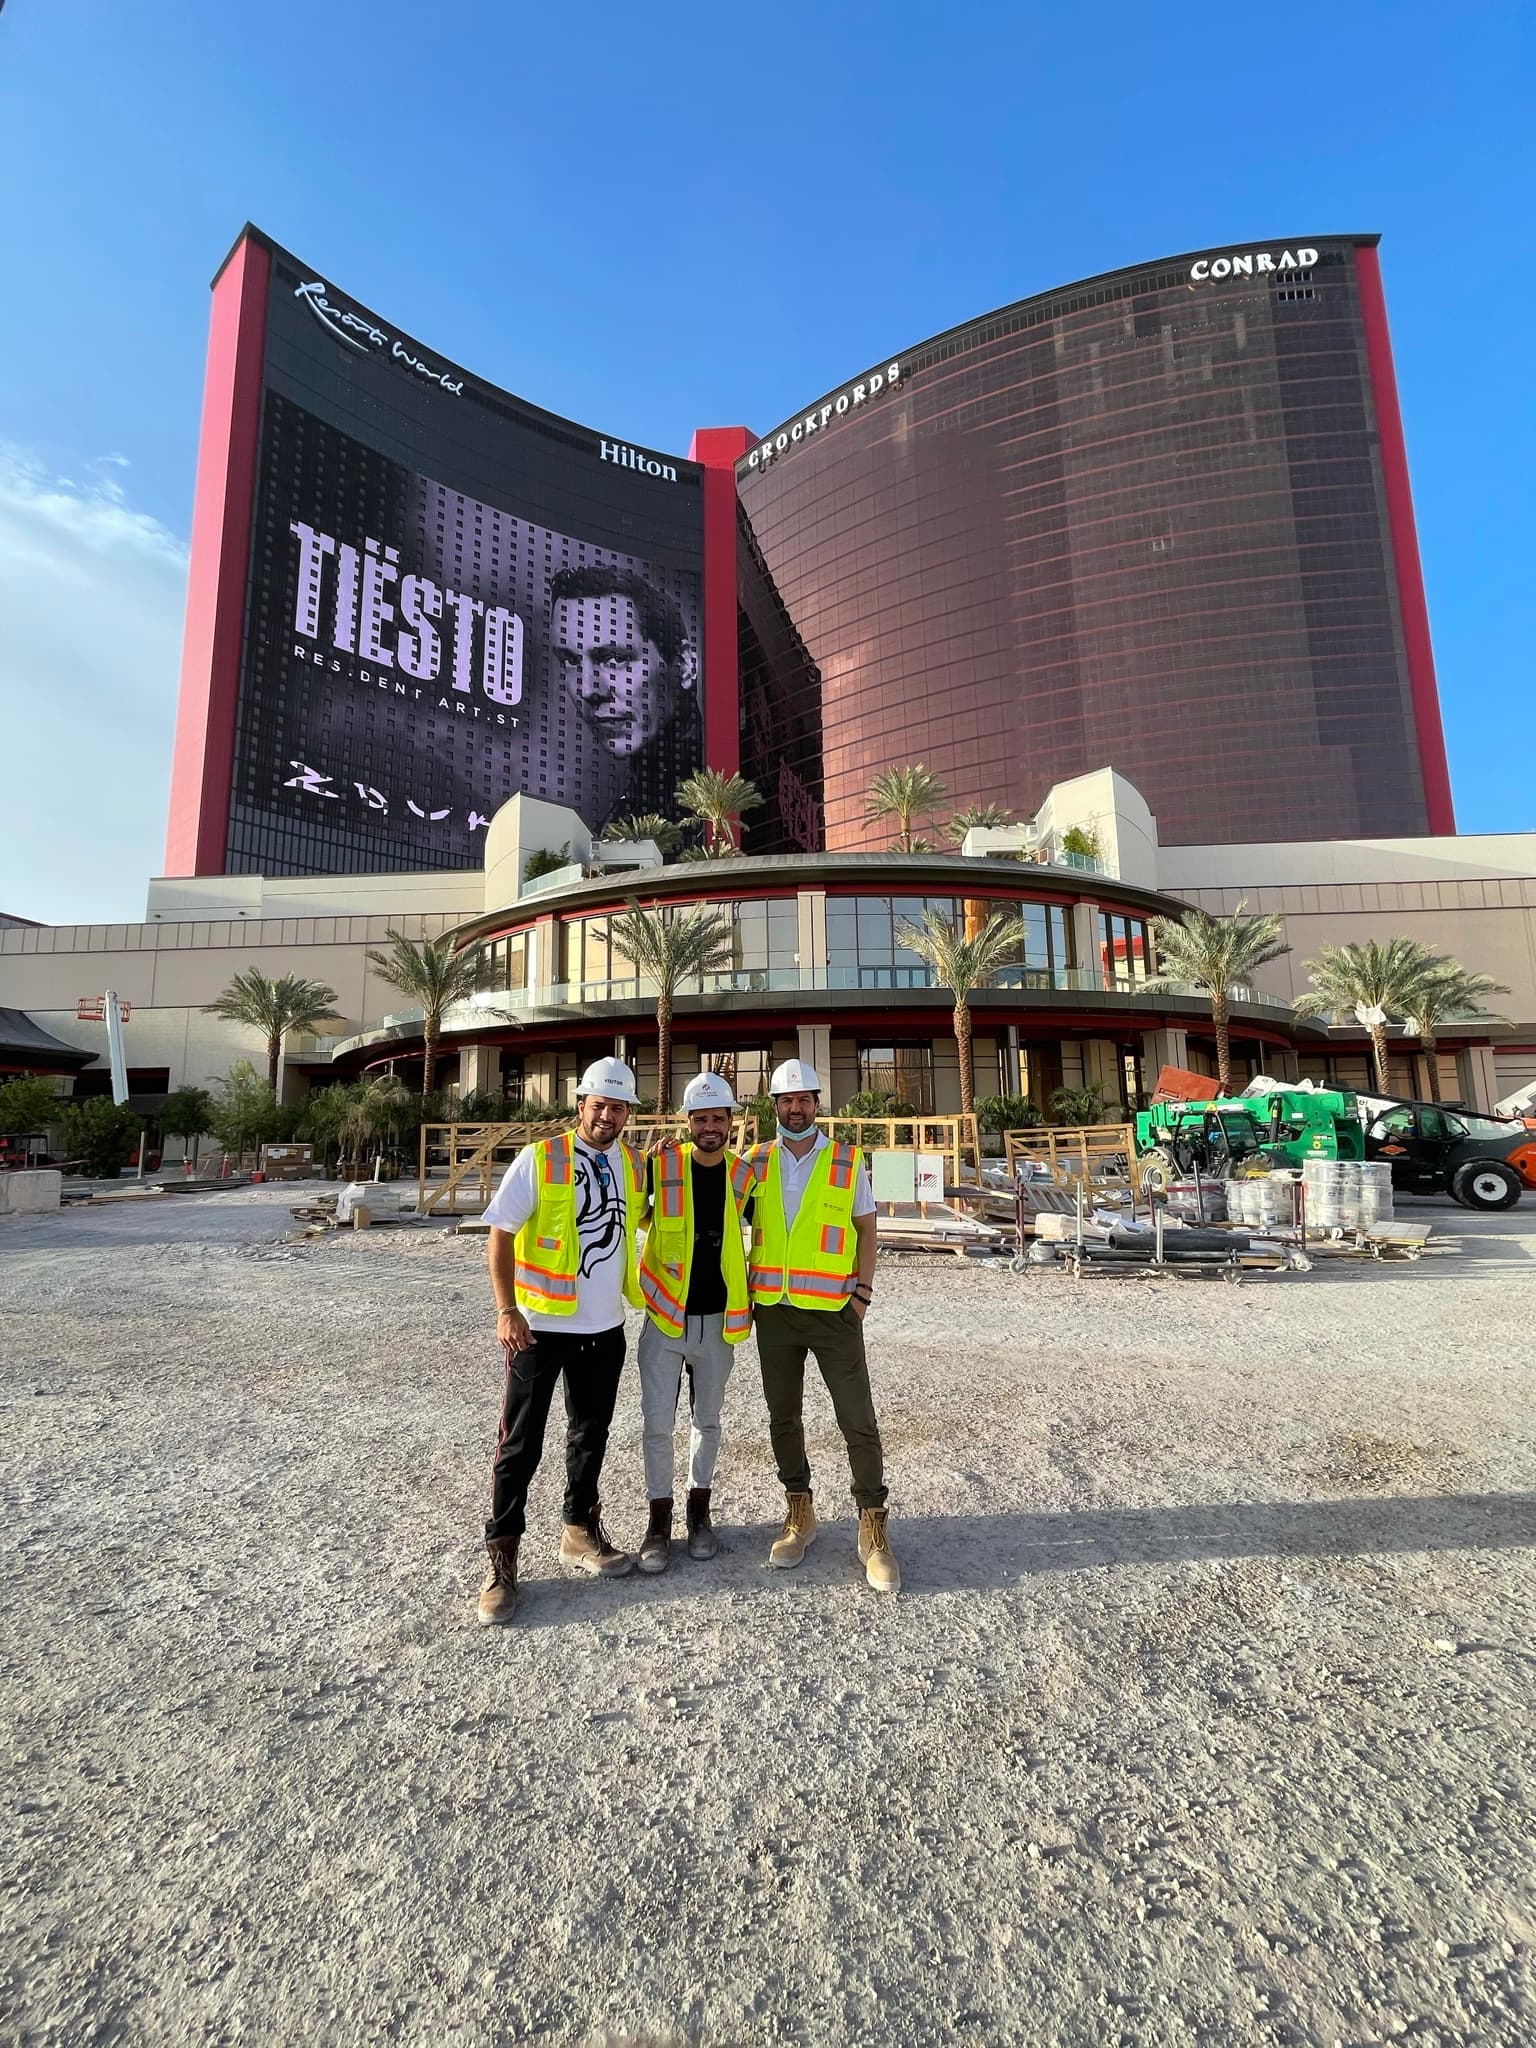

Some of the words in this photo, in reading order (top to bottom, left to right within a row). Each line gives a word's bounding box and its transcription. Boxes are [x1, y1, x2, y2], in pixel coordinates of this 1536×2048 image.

[1190, 248, 1319, 281] CONRAD
[391, 341, 465, 398] World
[748, 362, 900, 467] CROCKFORDS
[599, 440, 679, 483] Hilton
[289, 520, 525, 707] TIËSTO
[293, 644, 422, 700] RESDENT
[438, 696, 520, 729] ARTST
